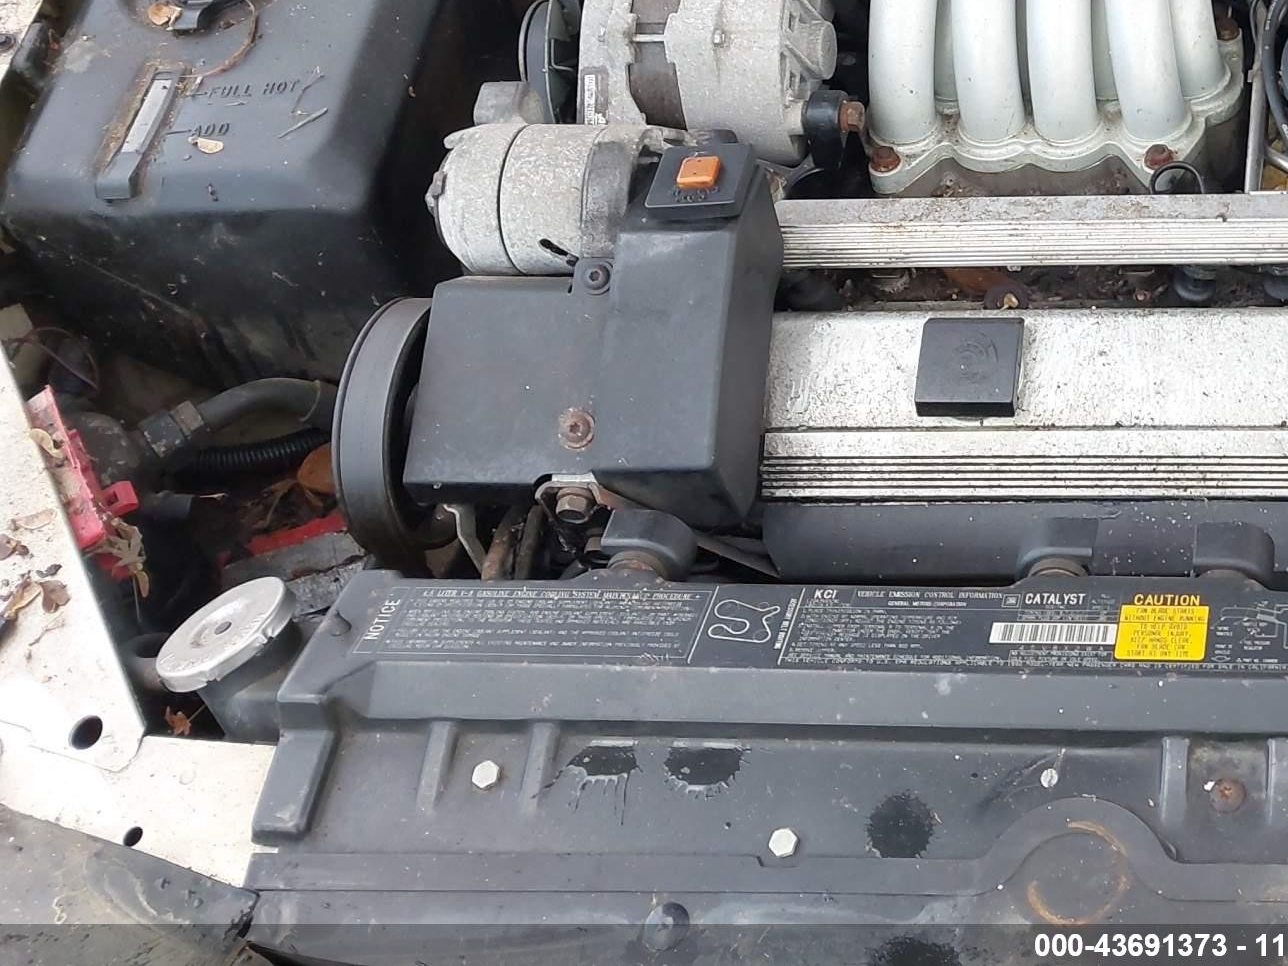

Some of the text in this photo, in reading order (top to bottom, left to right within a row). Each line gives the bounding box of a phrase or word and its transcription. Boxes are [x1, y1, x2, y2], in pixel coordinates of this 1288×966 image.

[208, 80, 301, 99] FULL HOT
[192, 123, 231, 136] ADD
[813, 589, 838, 599] KCI
[924, 591, 954, 599] CONTROL
[1024, 593, 1086, 606] CATALYST
[1133, 593, 1201, 606] CAUTION
[363, 599, 401, 640] NOTICE
